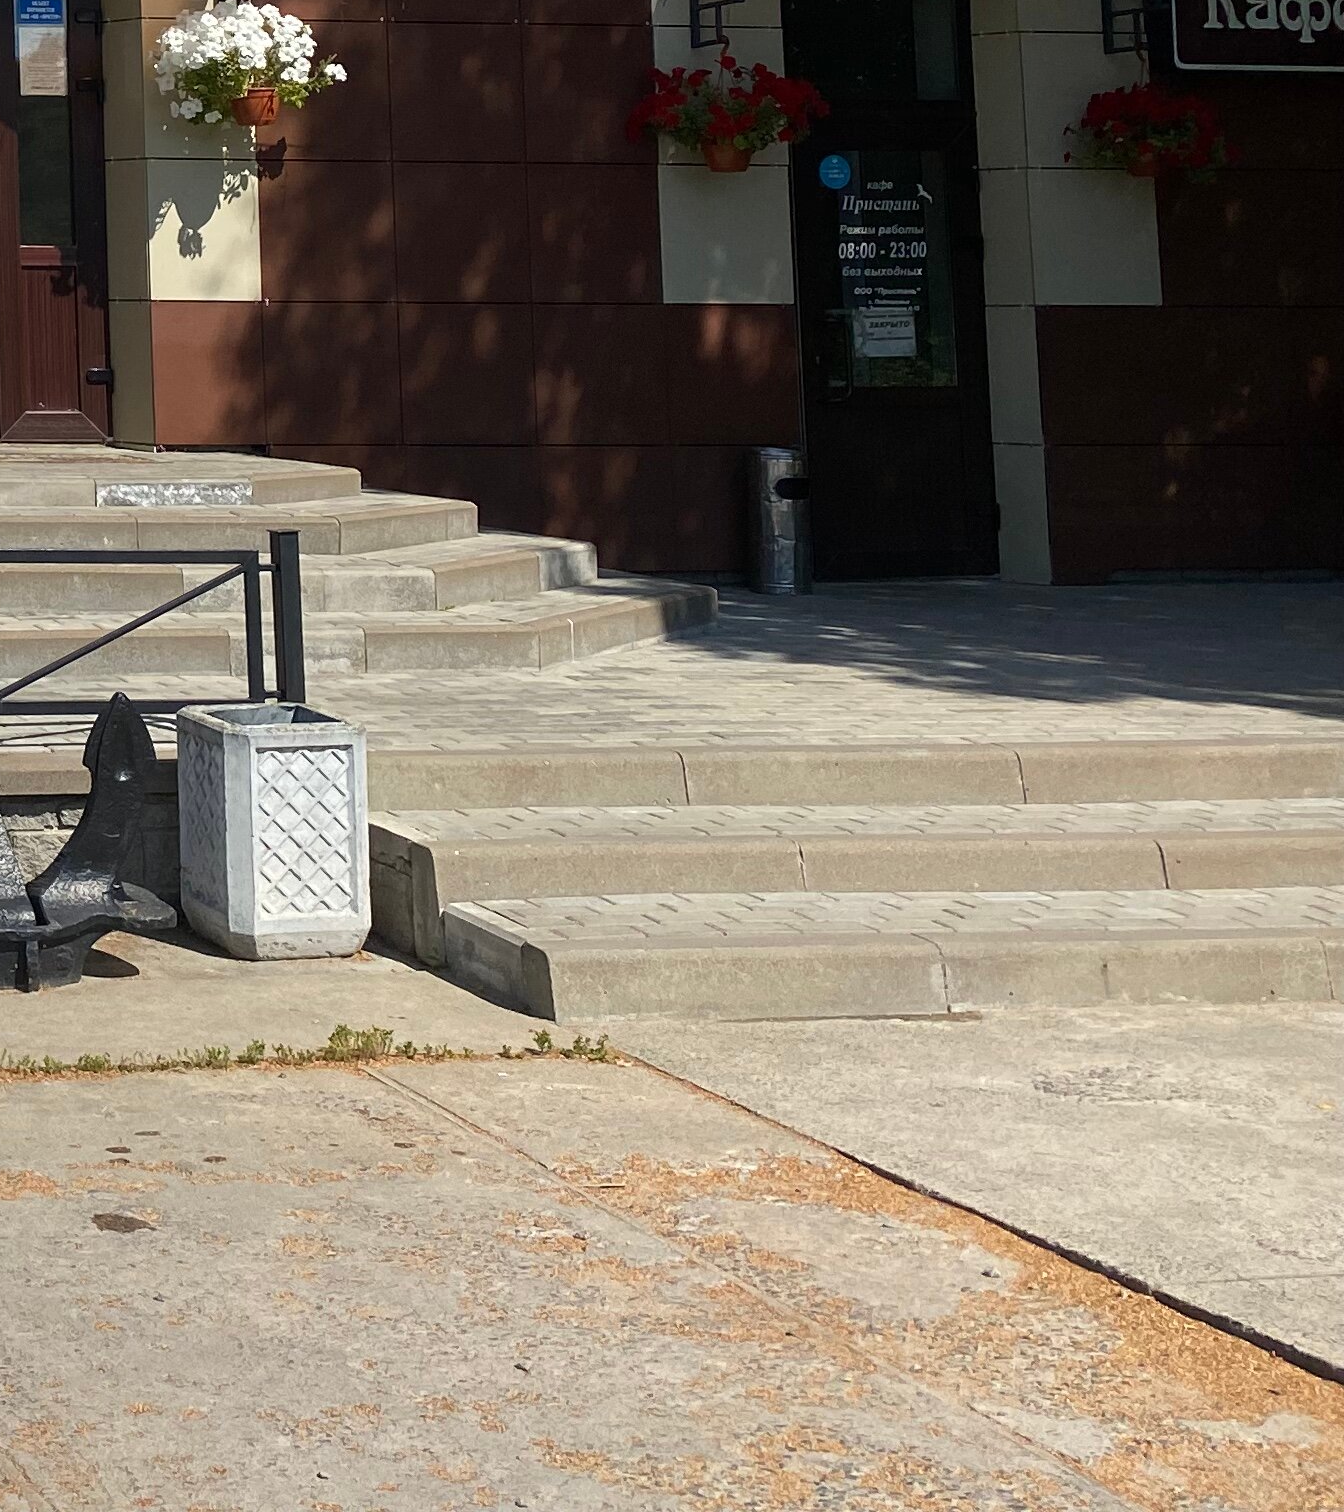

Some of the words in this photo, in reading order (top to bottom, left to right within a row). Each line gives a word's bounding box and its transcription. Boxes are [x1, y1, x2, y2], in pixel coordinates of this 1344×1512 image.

[867, 179, 894, 191] кафе
[842, 195, 920, 214] Пристань
[839, 224, 876, 234] Режим
[878, 223, 924, 236] работы
[838, 242, 877, 259] 08:00
[889, 241, 927, 258] 23:00
[842, 266, 861, 276] без
[864, 265, 923, 276] выходных
